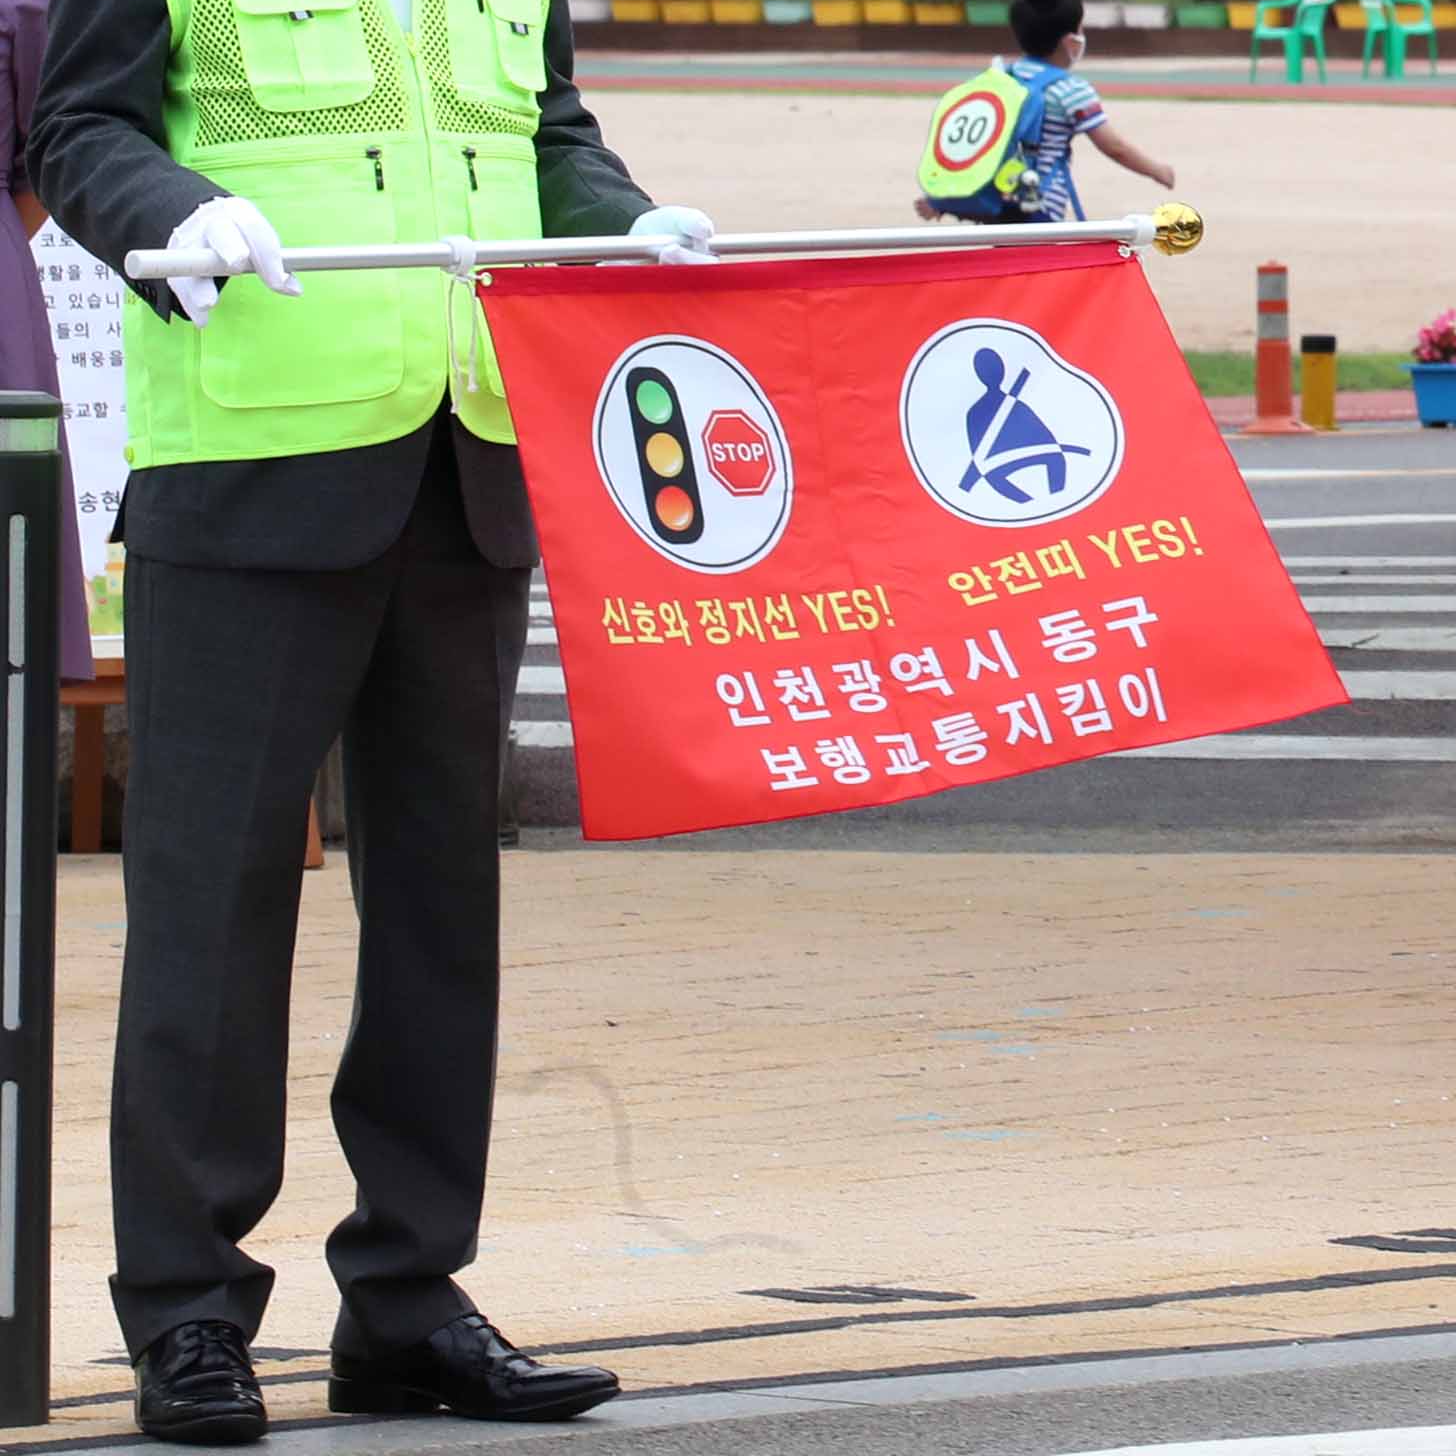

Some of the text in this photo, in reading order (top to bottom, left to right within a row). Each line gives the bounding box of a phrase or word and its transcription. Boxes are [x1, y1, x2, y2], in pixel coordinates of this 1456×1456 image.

[947, 115, 988, 145] 30
[711, 442, 765, 463] STOP
[947, 516, 1205, 607] 안전띠 YES!
[601, 584, 897, 647] 신호와 정지선 YES!
[715, 595, 1159, 728] 인천광역시 동구
[759, 666, 1169, 792] 보행교통지킴이
